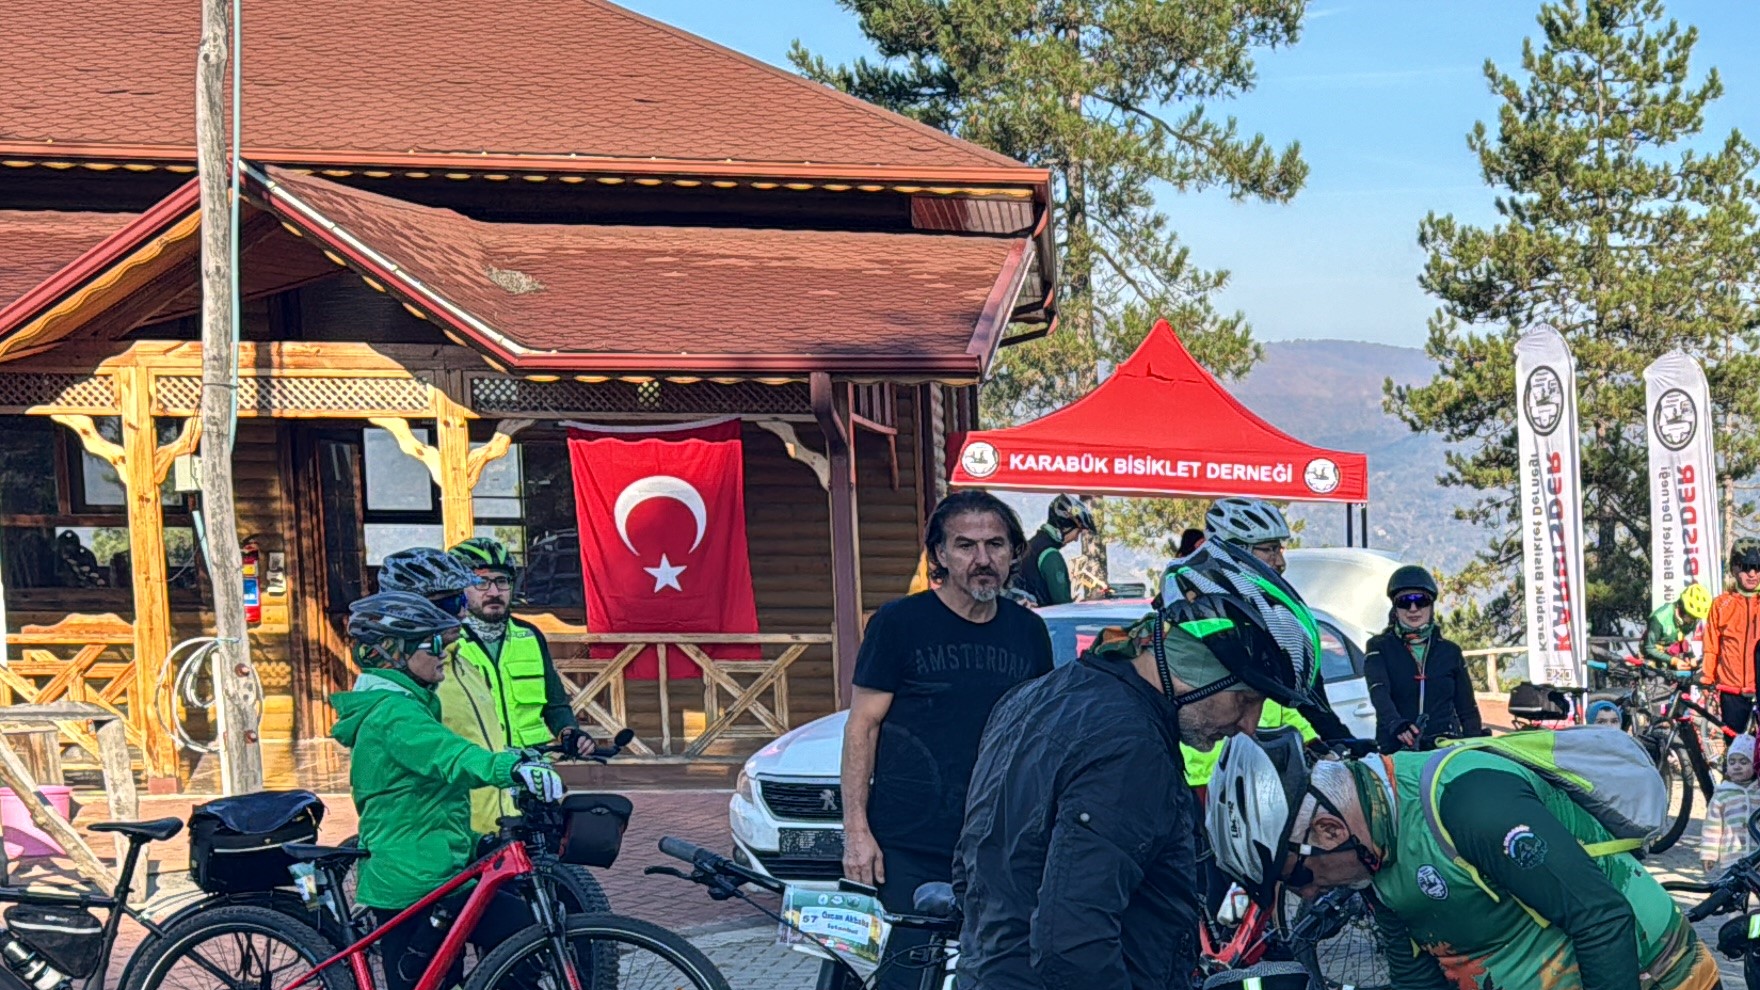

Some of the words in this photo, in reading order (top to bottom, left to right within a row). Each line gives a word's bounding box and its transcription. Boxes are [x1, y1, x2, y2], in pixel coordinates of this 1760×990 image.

[1009, 453, 1109, 475] KARABÜK
[1114, 454, 1201, 479] BİSİKLET
[1206, 460, 1293, 483] DERNEĞİ
